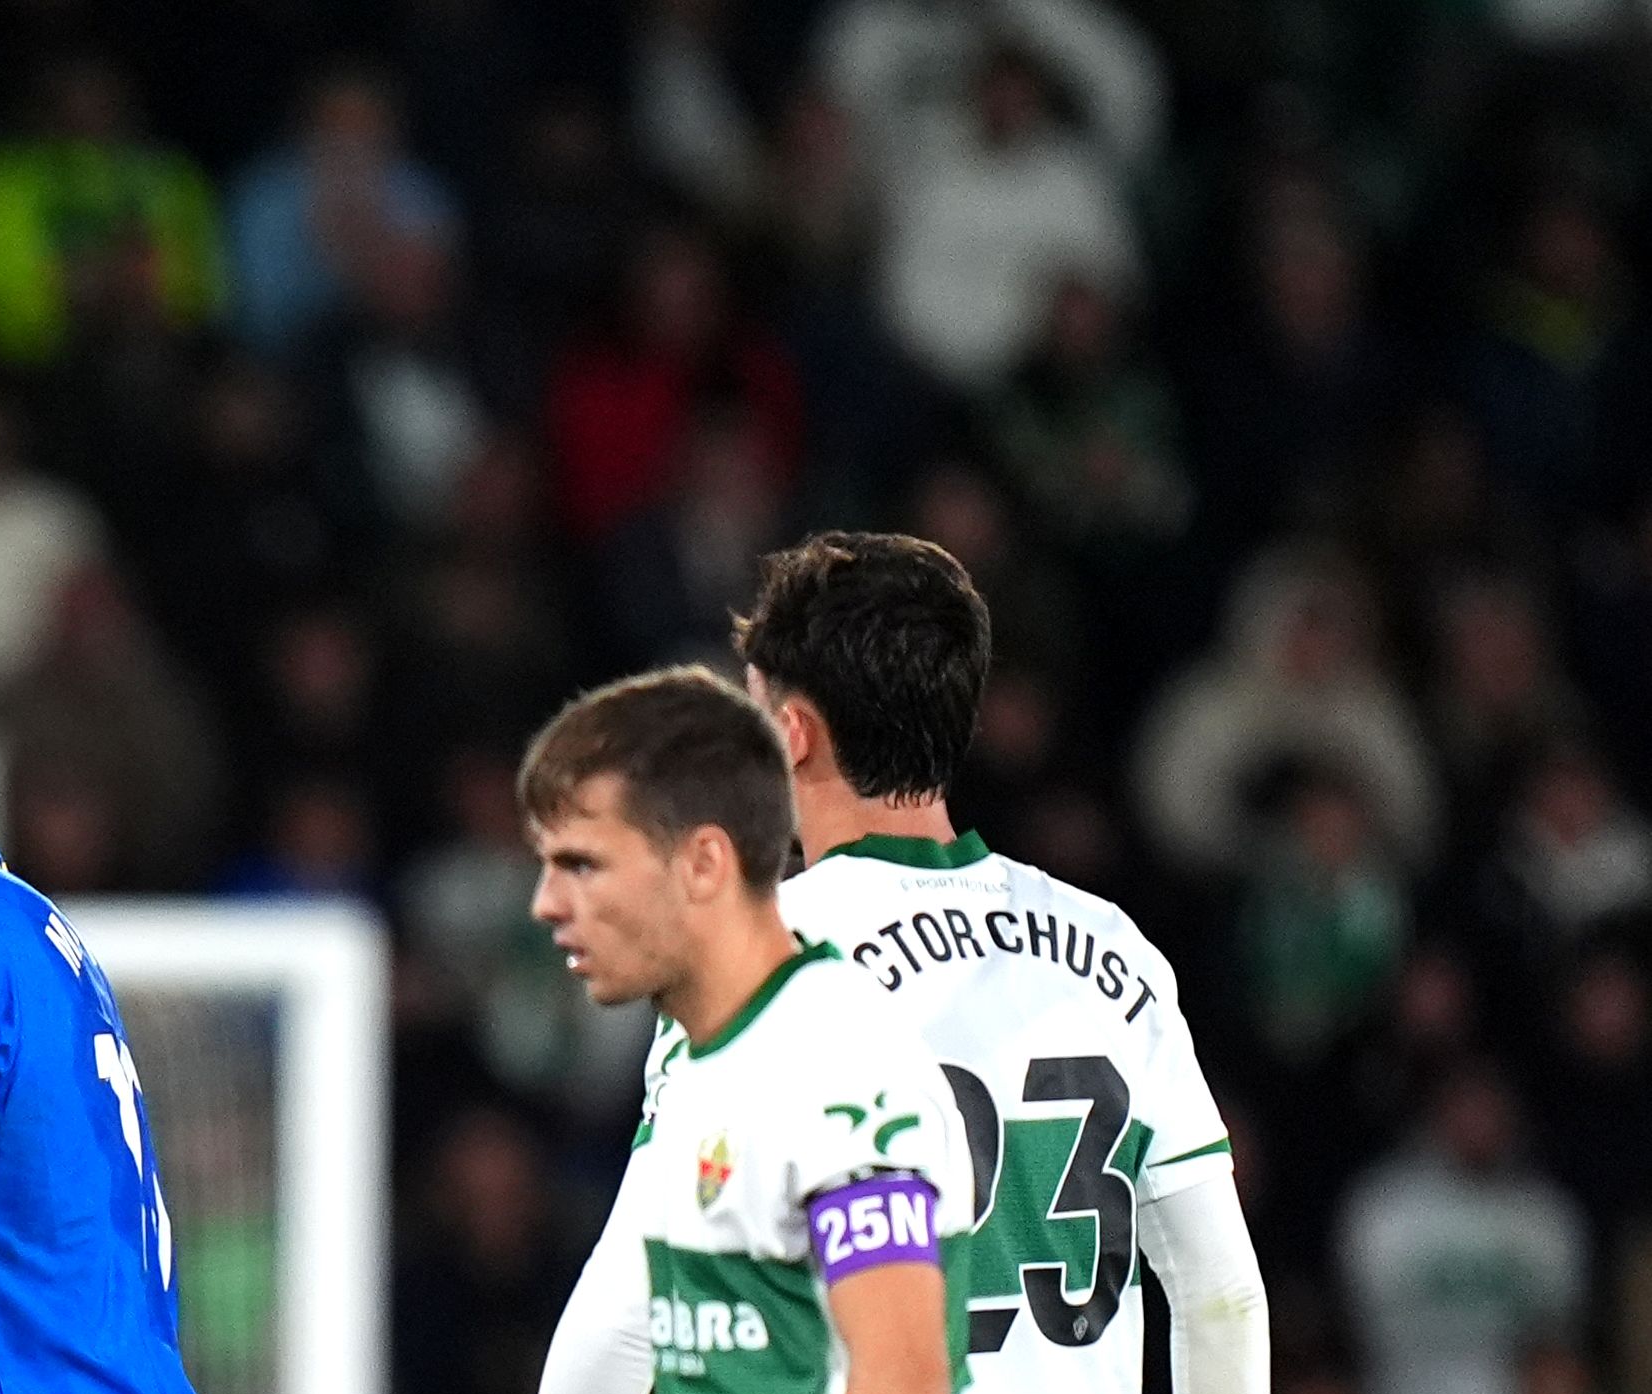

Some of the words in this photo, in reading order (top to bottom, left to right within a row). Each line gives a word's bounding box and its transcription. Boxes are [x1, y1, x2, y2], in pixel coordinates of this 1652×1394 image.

[852, 908, 986, 992] CTOR
[985, 910, 1157, 1025] CHUST
[815, 1191, 930, 1266] 25N
